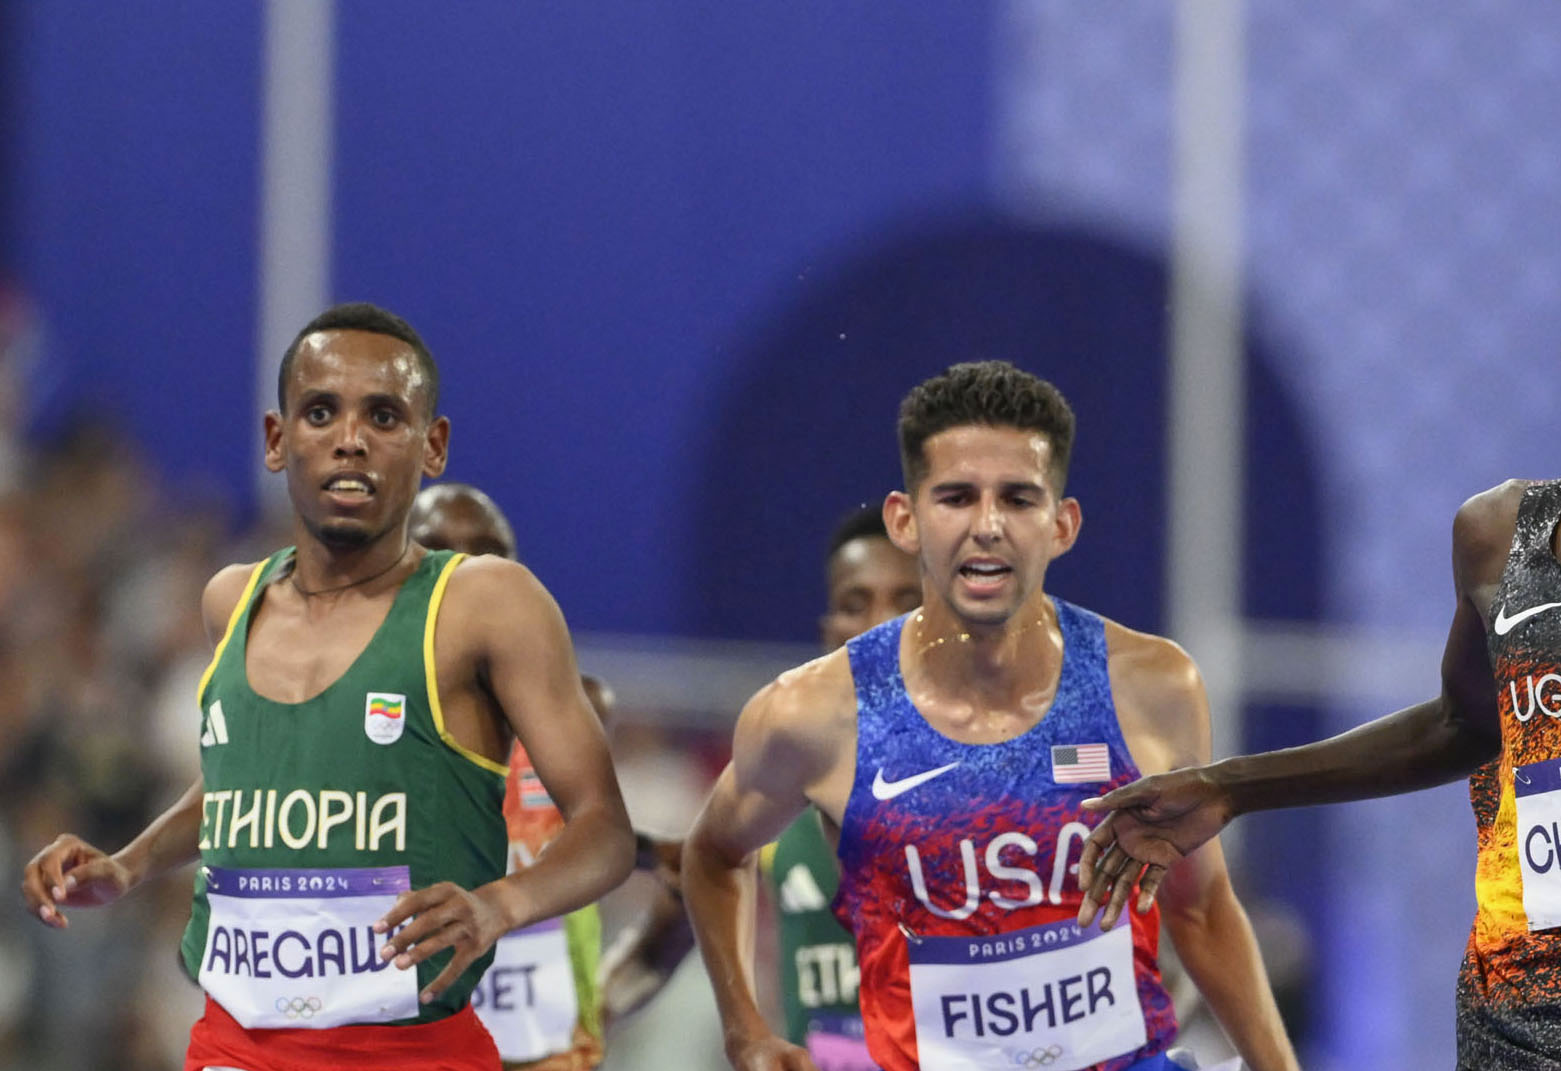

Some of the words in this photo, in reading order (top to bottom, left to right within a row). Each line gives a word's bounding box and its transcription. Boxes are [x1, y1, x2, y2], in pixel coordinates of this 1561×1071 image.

[199, 789, 407, 852] ETHIOPIA
[239, 876, 292, 892] PARIS
[297, 876, 349, 892] 2024
[207, 925, 406, 979] AREGAW
[969, 937, 1026, 957] PARIS
[1031, 926, 1083, 948] 2024
[940, 966, 1115, 1038] FISHER
